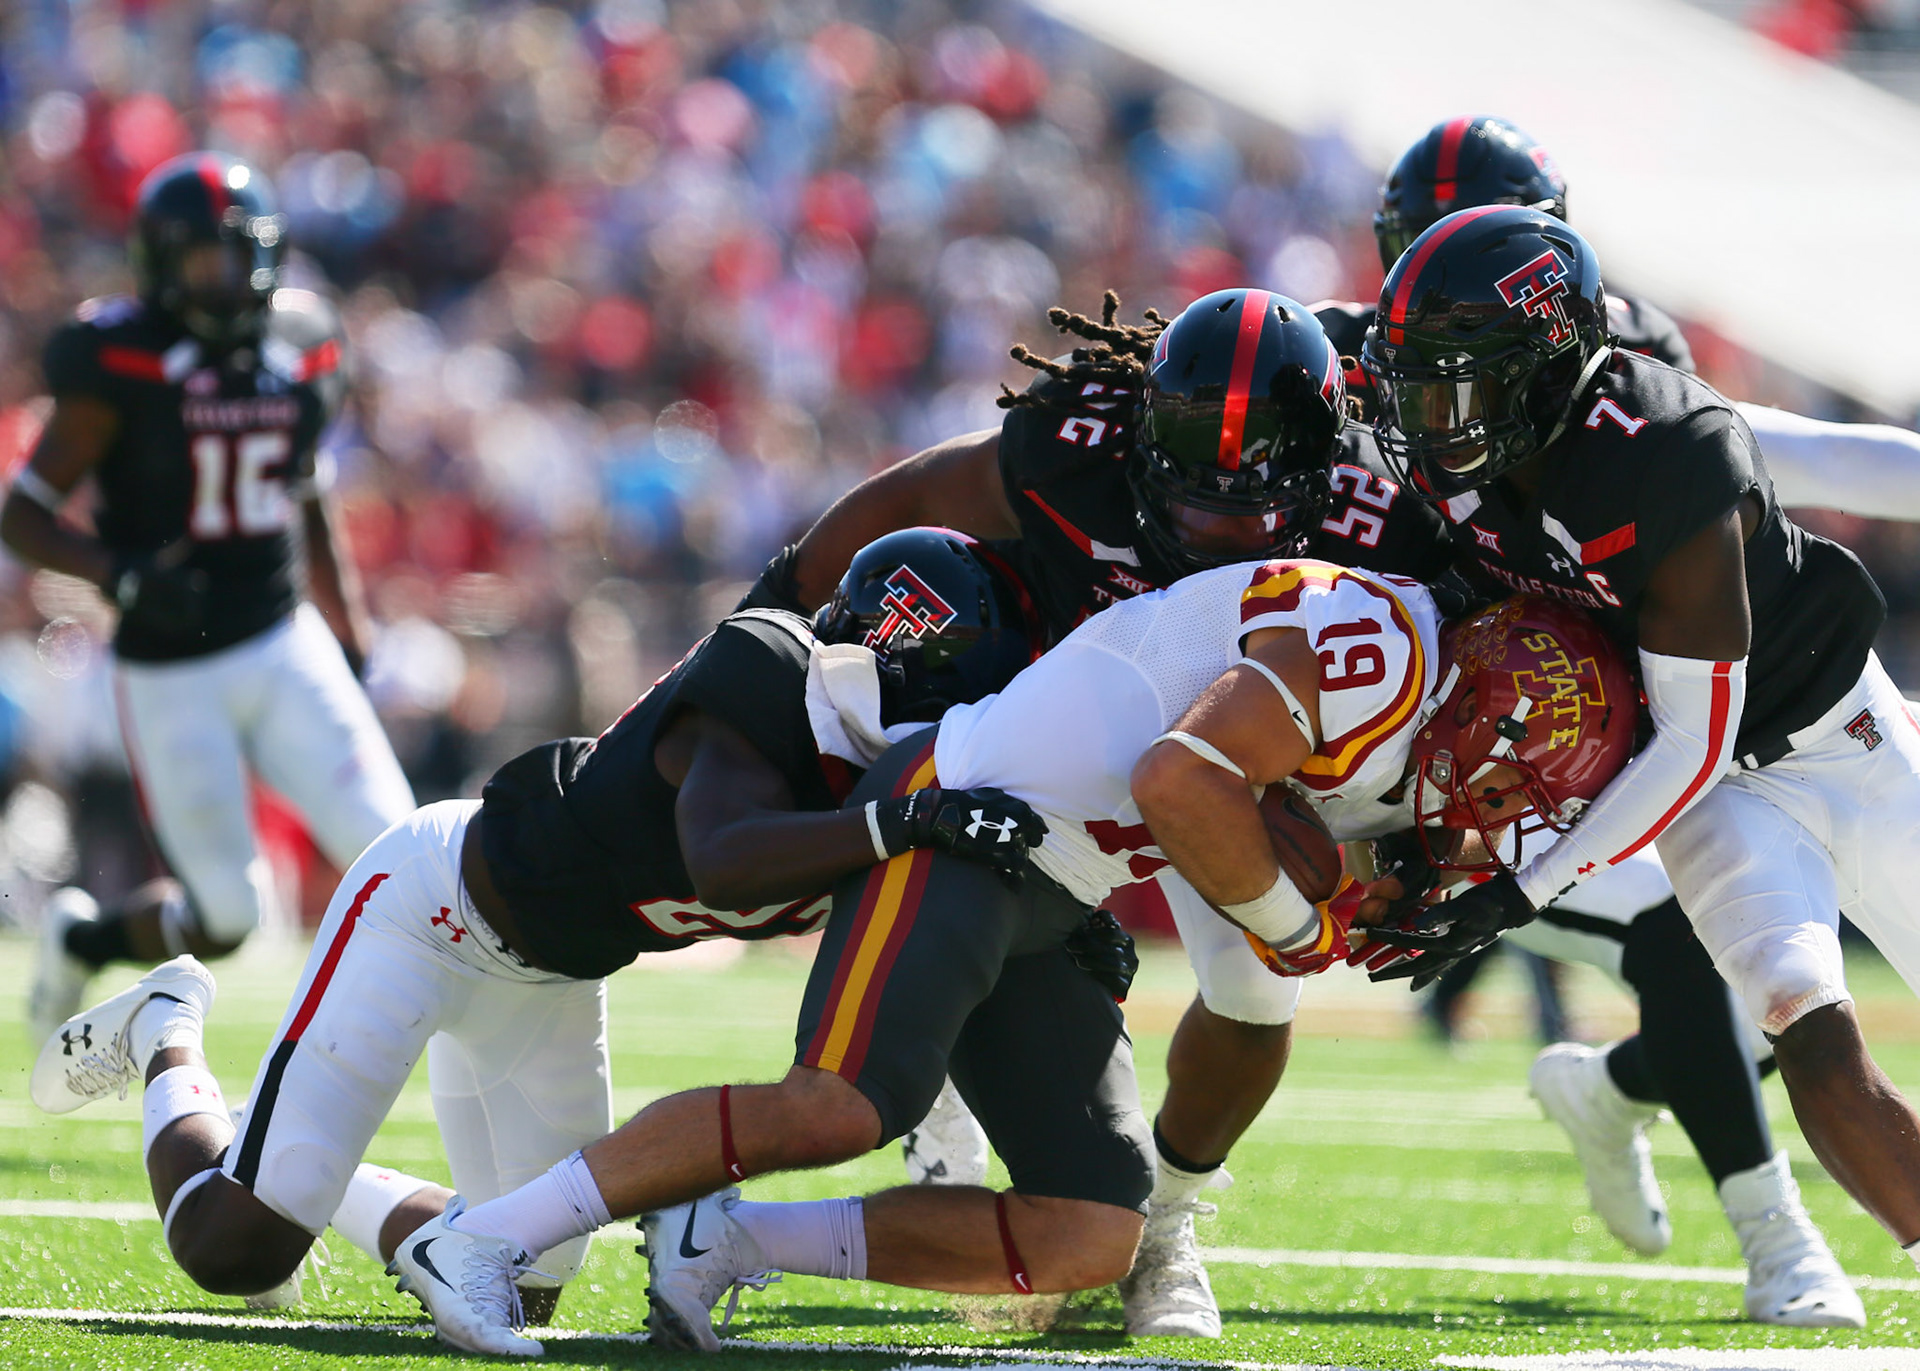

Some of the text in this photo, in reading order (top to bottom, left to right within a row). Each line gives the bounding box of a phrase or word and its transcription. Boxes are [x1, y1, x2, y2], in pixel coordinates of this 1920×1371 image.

[1584, 396, 1649, 438] 7
[190, 430, 290, 537] 16
[1321, 463, 1400, 548] 52
[1478, 558, 1603, 609] TEXAS TECH
[1584, 571, 1623, 608] C
[1315, 617, 1386, 692] 19
[1520, 632, 1582, 751] STATE
